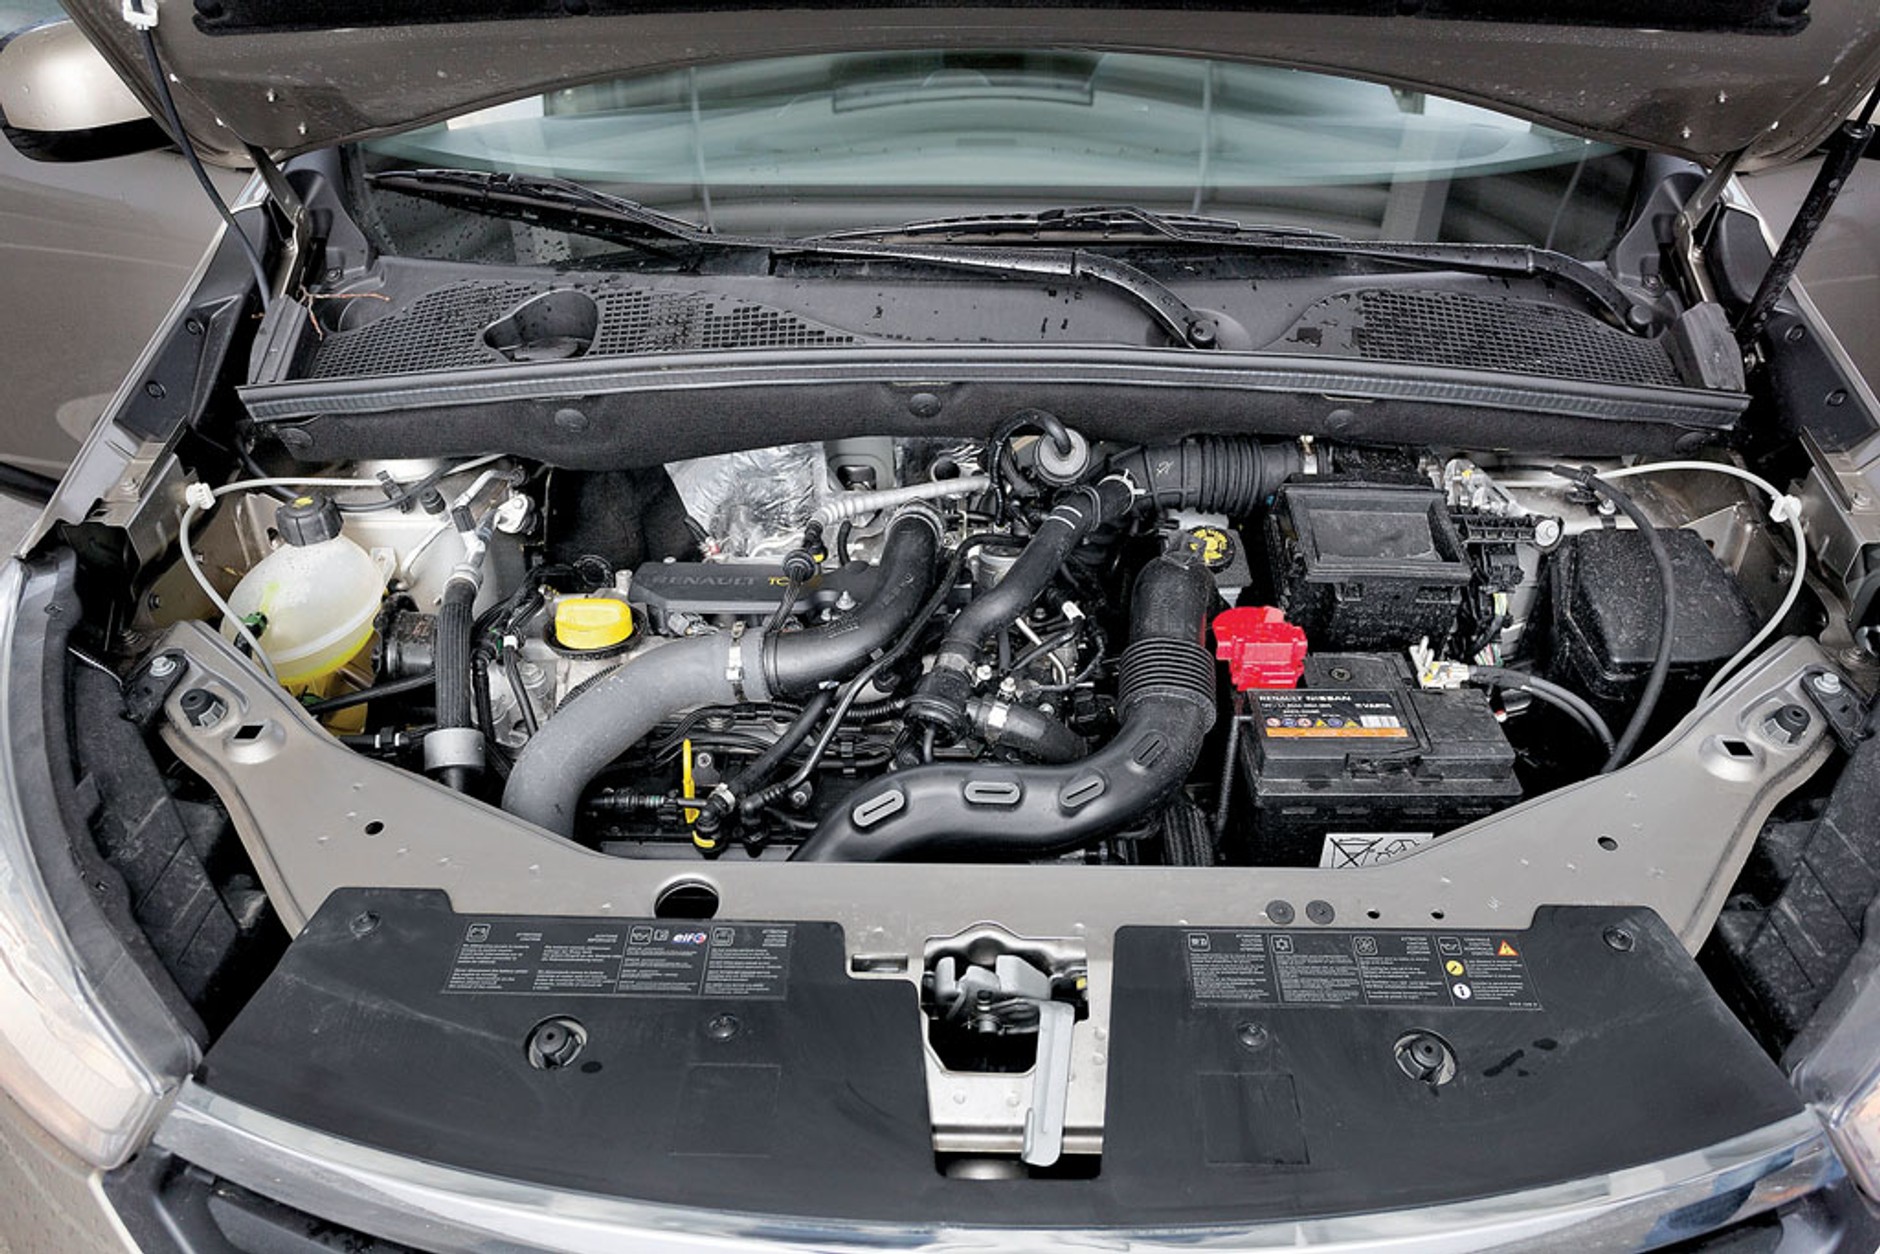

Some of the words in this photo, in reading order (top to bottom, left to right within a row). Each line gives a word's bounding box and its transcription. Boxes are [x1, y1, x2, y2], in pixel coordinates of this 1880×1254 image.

[651, 576, 755, 586] RENAULT
[767, 576, 791, 587] TC
[672, 931, 697, 944] elf
